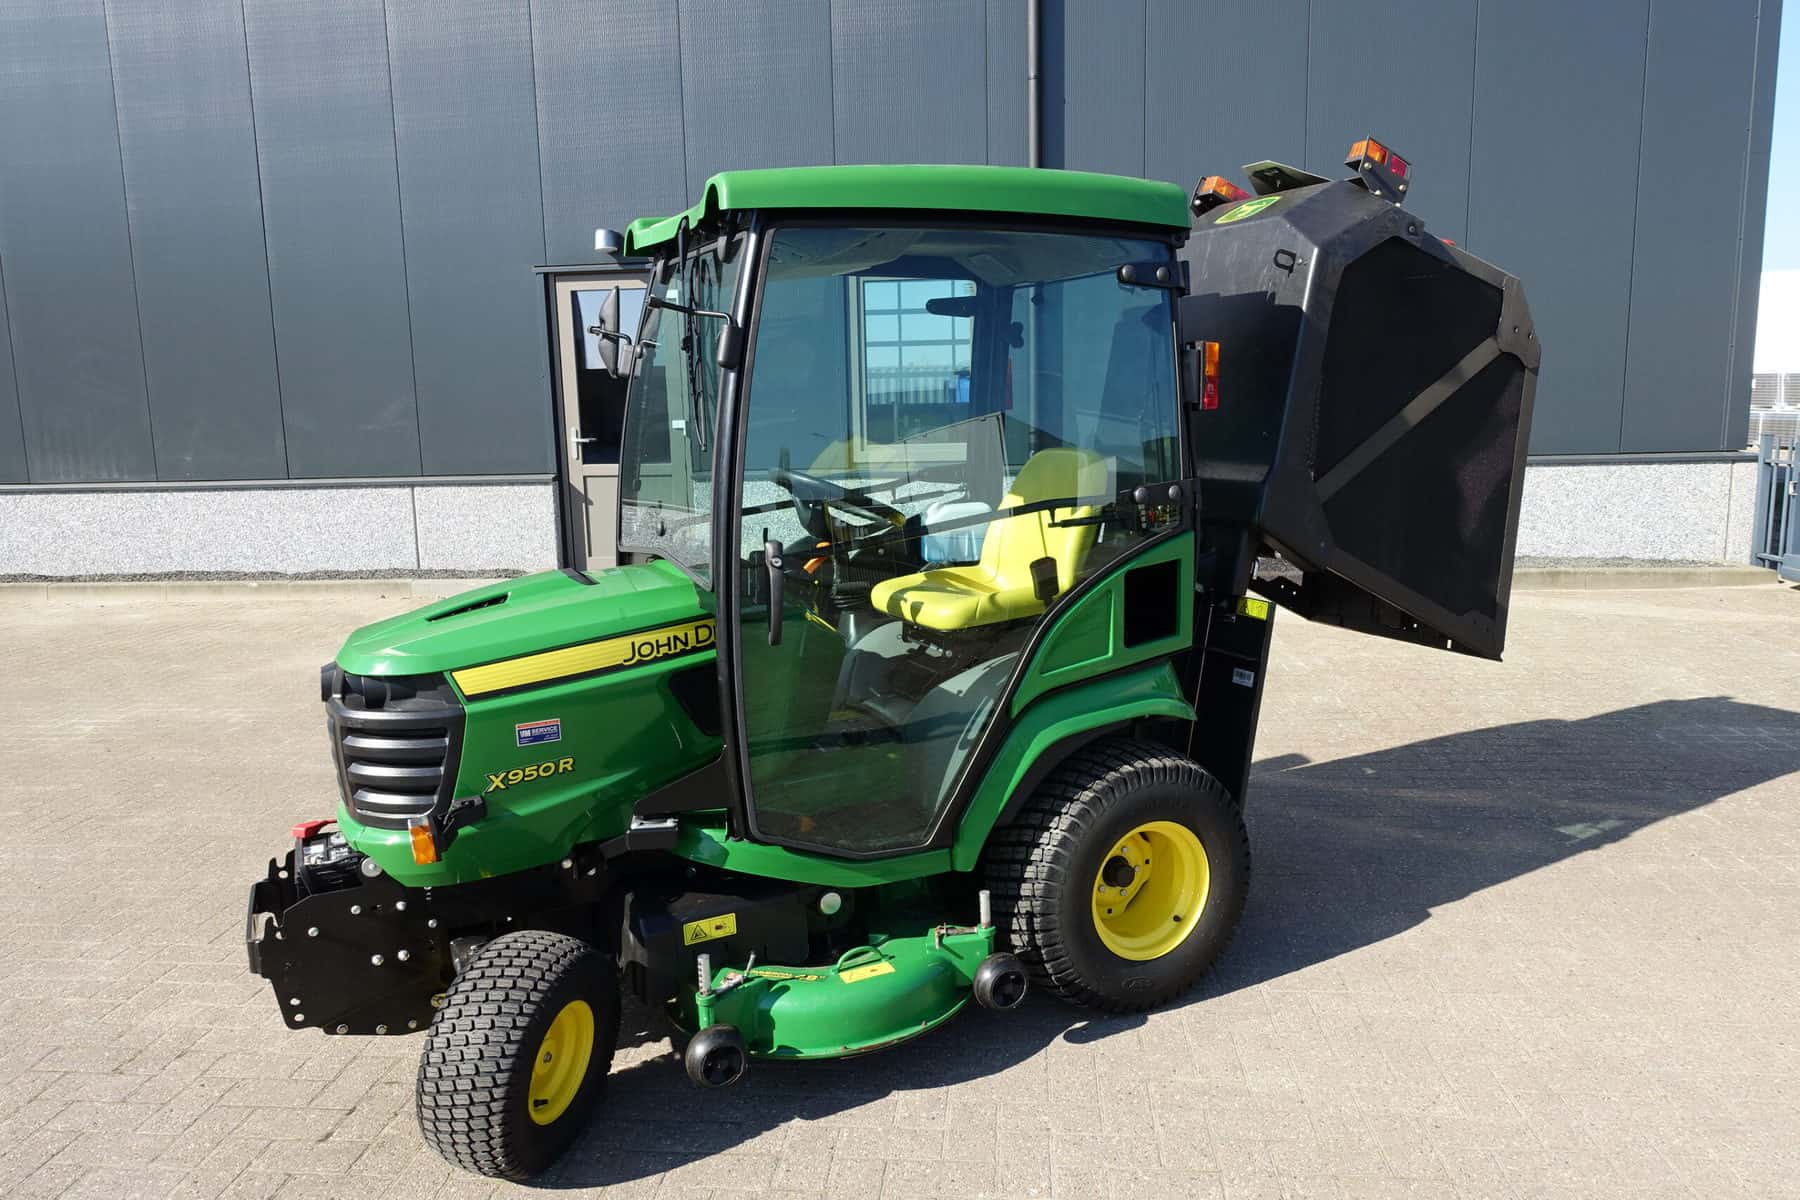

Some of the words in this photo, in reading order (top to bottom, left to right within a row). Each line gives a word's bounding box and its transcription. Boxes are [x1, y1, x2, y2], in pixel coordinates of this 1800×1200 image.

[623, 631, 689, 664] JOHN
[694, 623, 717, 646] D
[485, 757, 575, 793] X950R
